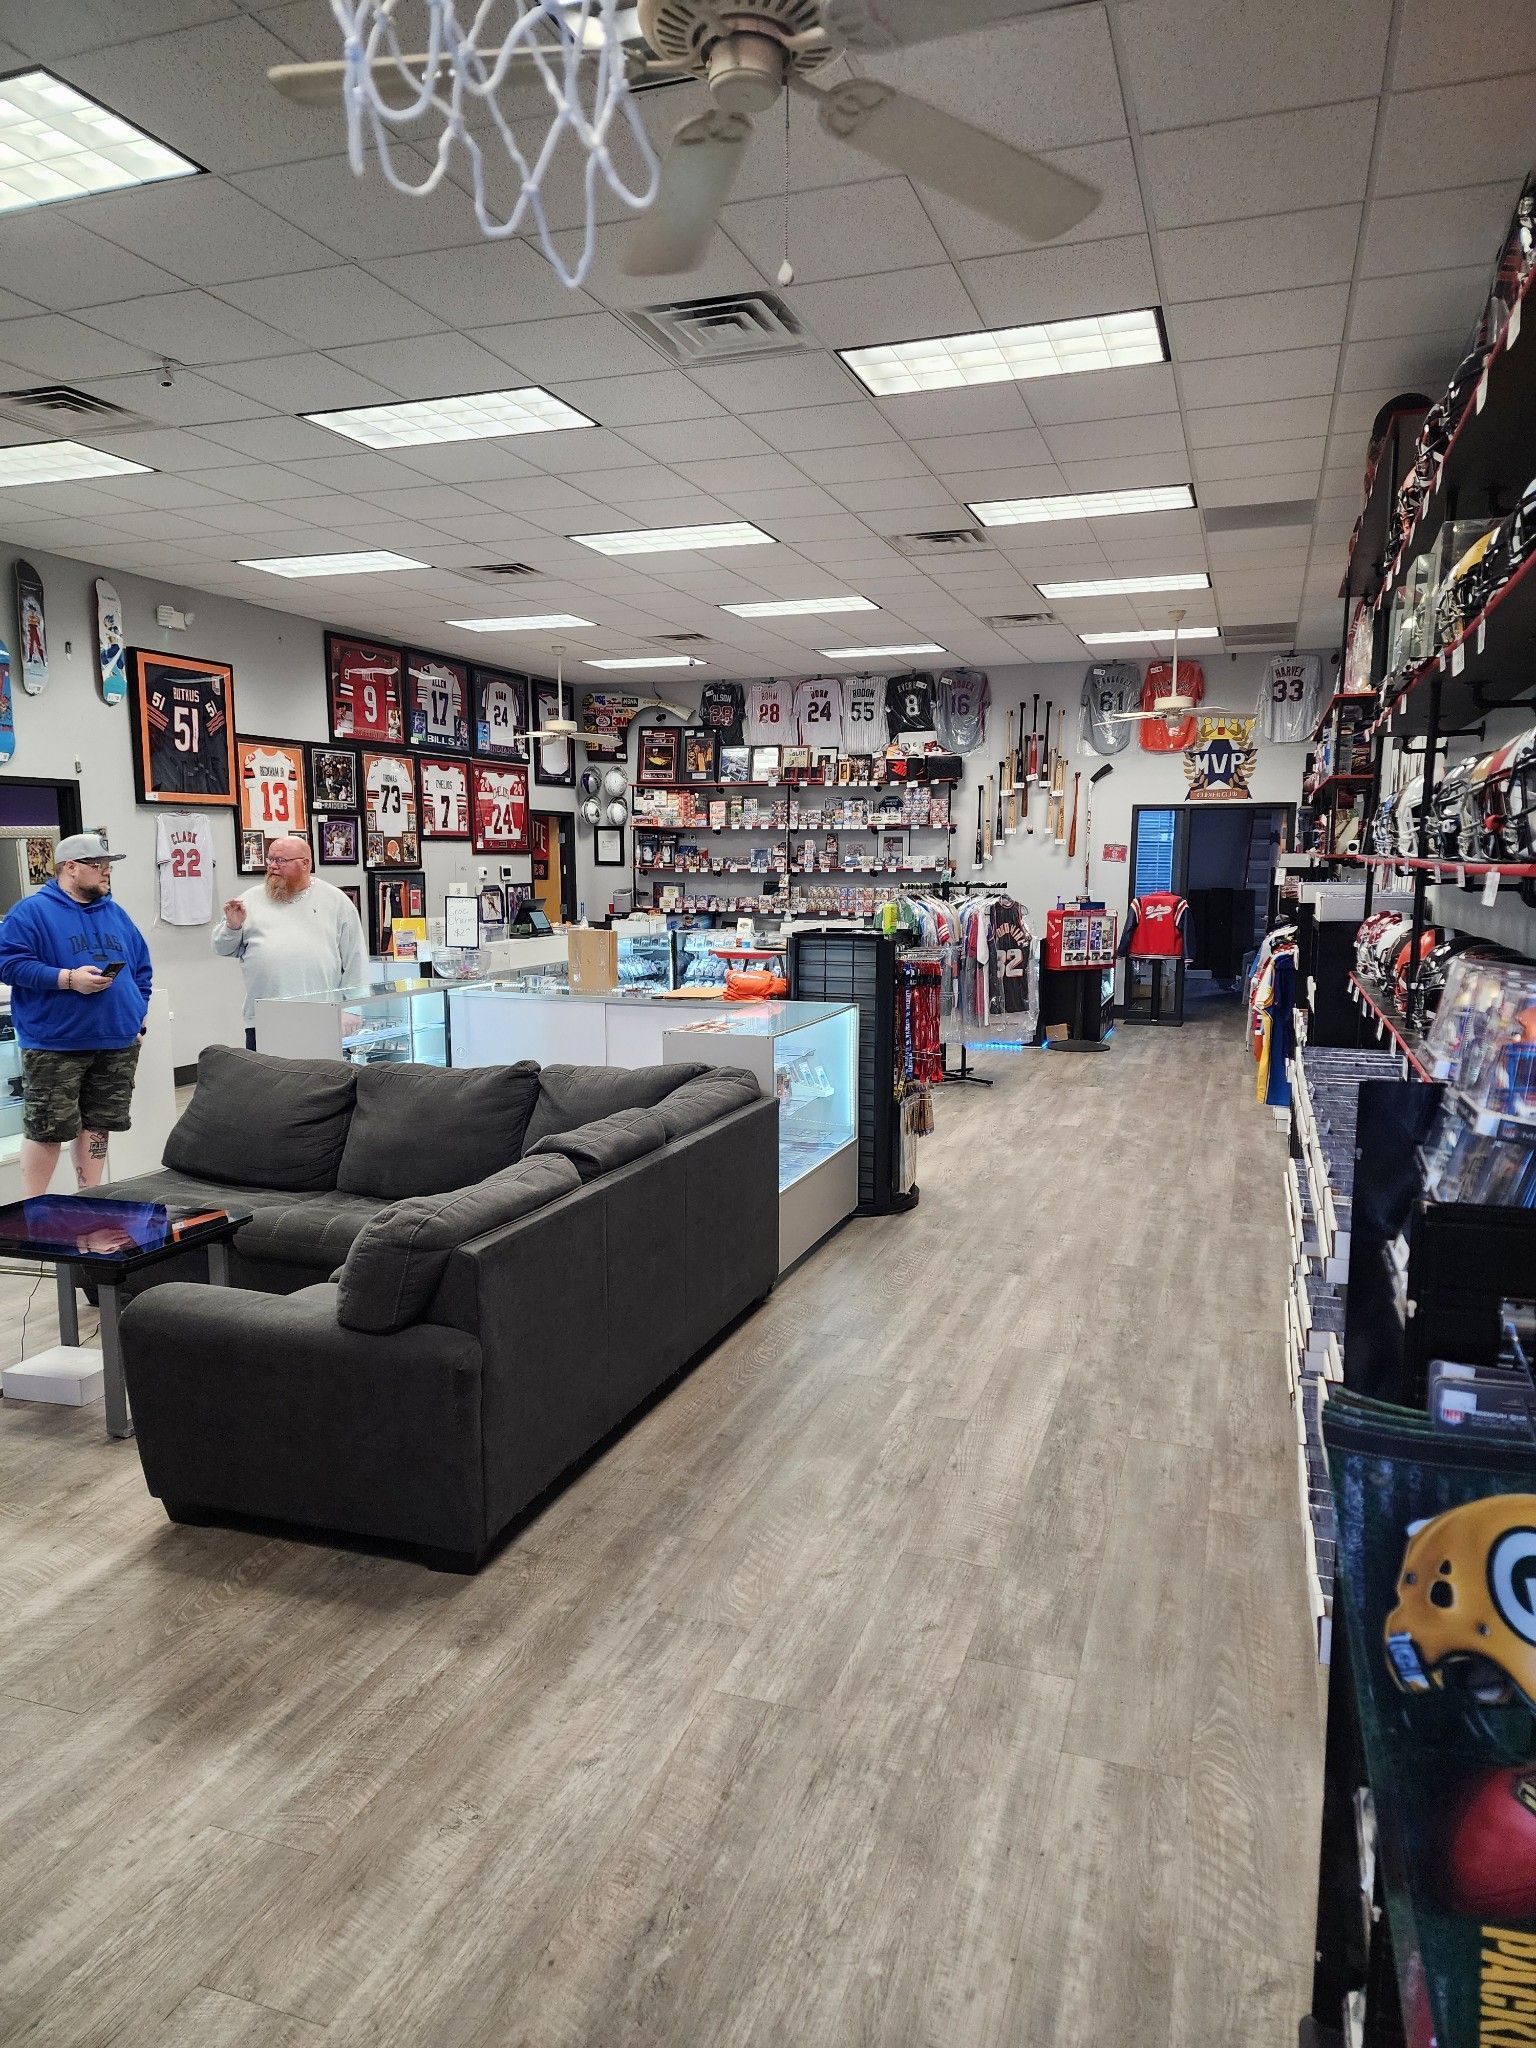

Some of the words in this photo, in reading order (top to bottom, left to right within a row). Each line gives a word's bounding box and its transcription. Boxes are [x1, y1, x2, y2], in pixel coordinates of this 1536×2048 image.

[1275, 666, 1305, 678] HARVEY
[432, 679, 447, 689] ALLEN
[1272, 680, 1304, 702] 33
[152, 691, 166, 711] 51
[173, 687, 200, 703] BUTKUS
[364, 686, 377, 722] 9
[712, 693, 732, 703] OLSON
[905, 694, 920, 716] 8
[1100, 691, 1123, 712] 61
[205, 700, 218, 718] 51
[431, 690, 449, 726] 17
[493, 704, 509, 728] 24
[709, 704, 734, 727] 28
[759, 703, 780, 724] 28
[808, 700, 832, 723] 24
[851, 701, 875, 722] 55
[174, 705, 200, 754] 51
[613, 717, 627, 726] 3M
[427, 734, 455, 746] BILLS
[260, 766, 279, 778] BECKHAM
[1194, 753, 1246, 775] MVP
[382, 774, 398, 783] THOMAS
[435, 780, 453, 790] CHELIOS
[480, 779, 490, 792] 24
[513, 783, 523, 795] 24
[260, 782, 290, 822] 13
[324, 802, 348, 810] RAIDERS
[380, 785, 402, 814] 73
[441, 795, 450, 829] 7
[494, 804, 513, 835] 24
[171, 831, 198, 845] CLARK
[171, 848, 202, 878] 22
